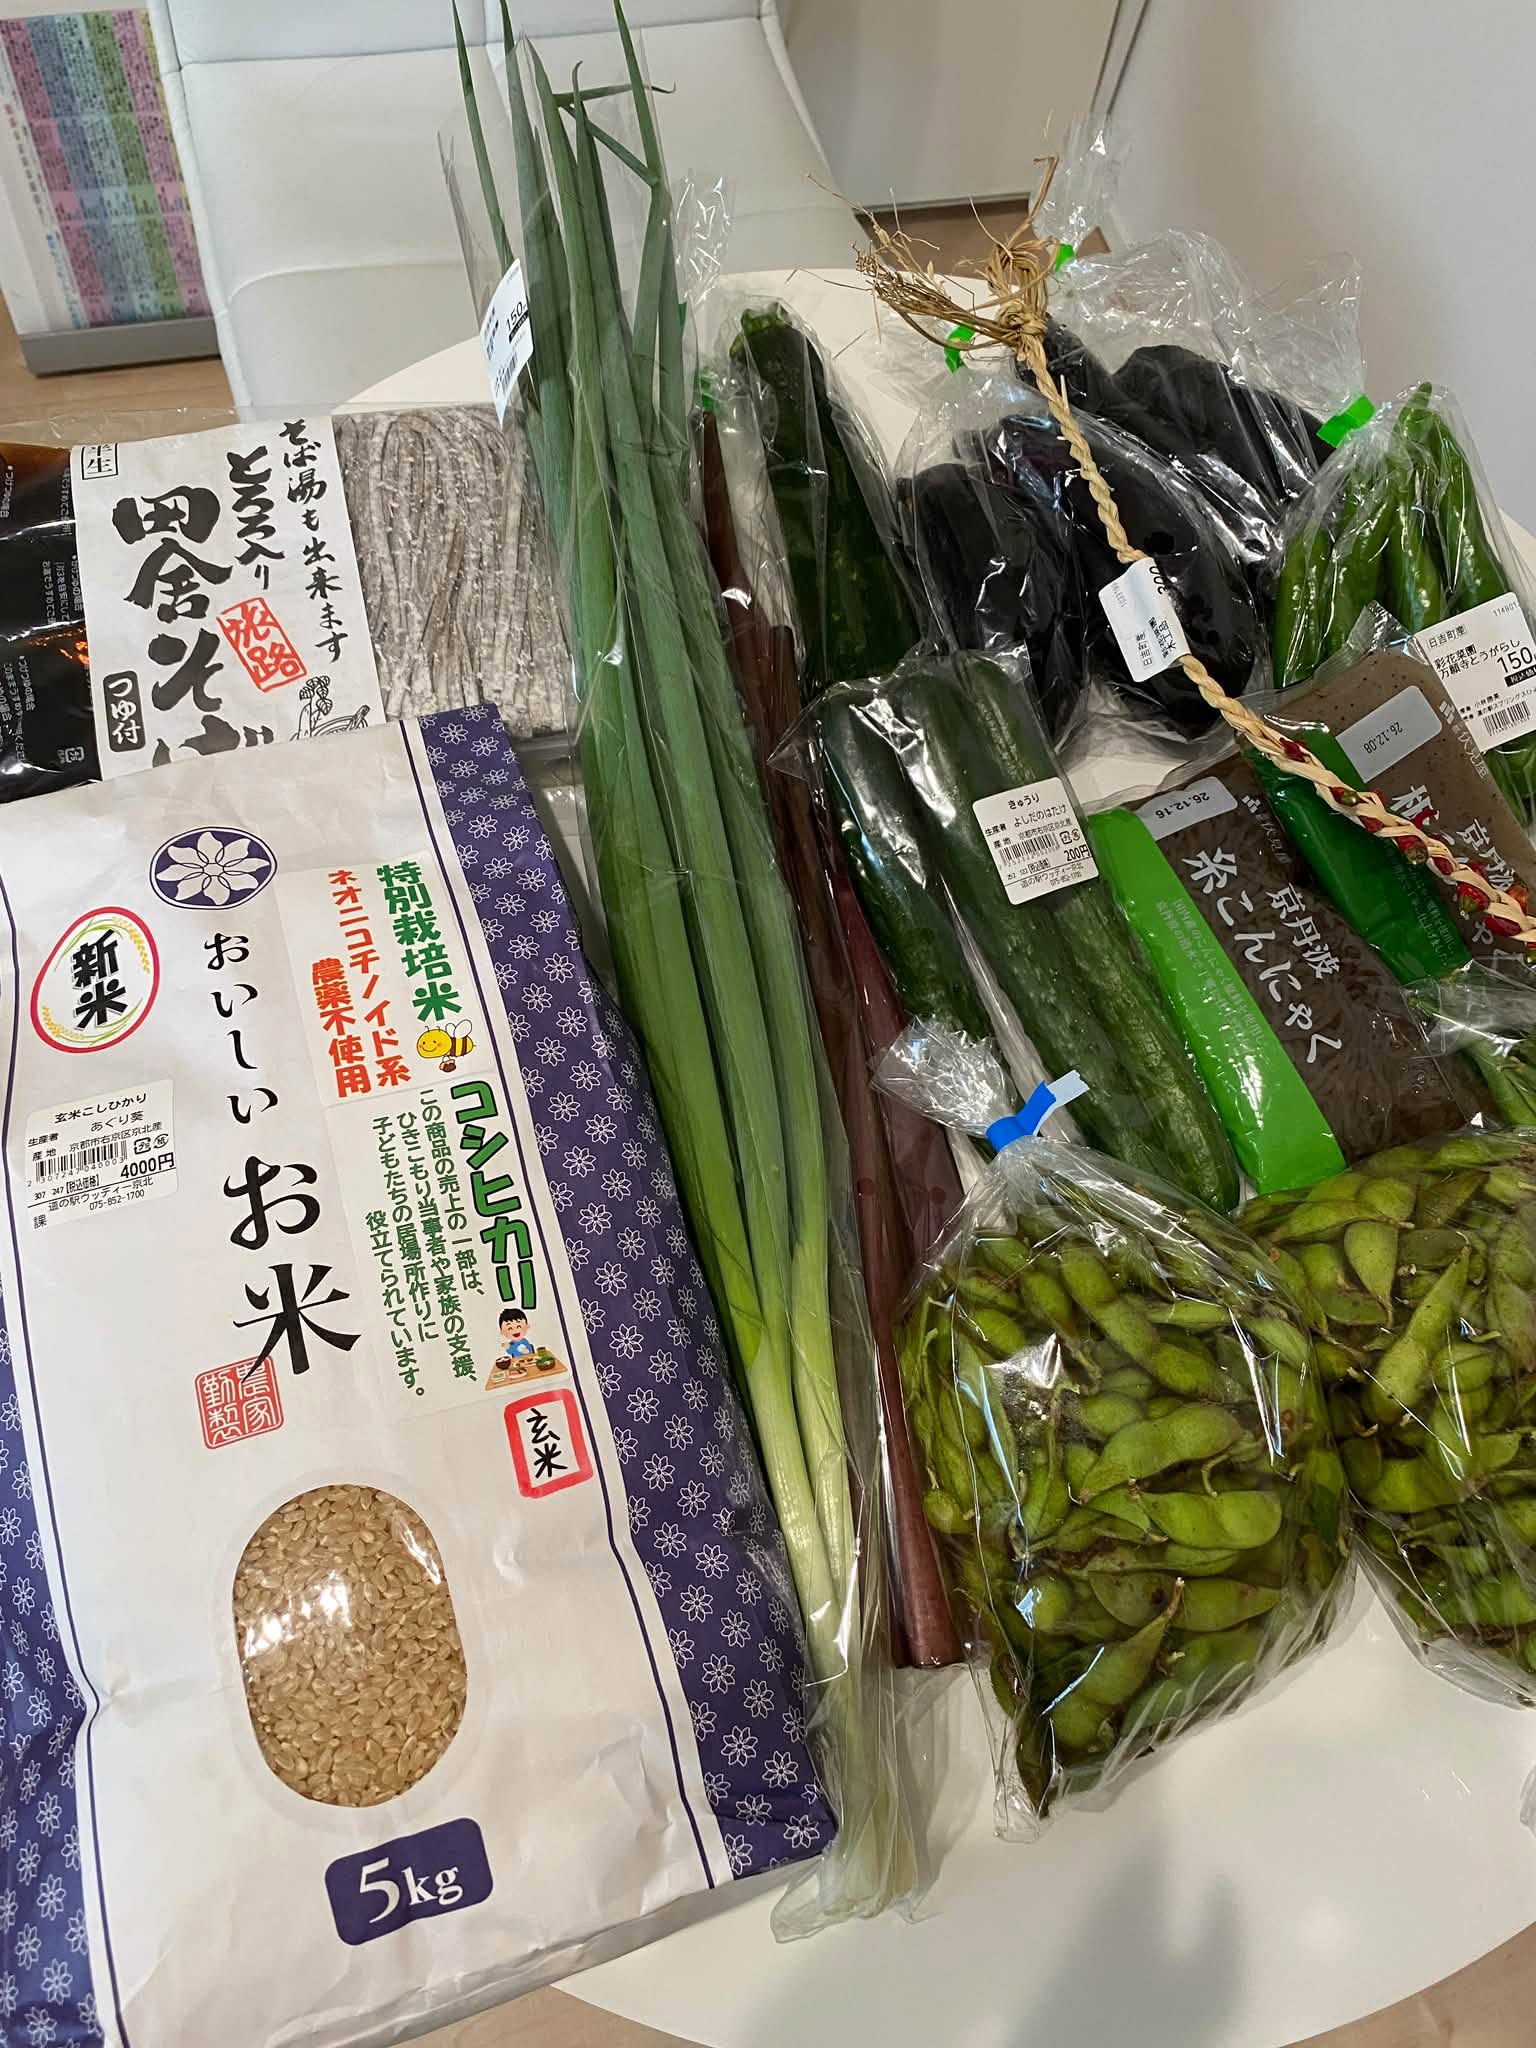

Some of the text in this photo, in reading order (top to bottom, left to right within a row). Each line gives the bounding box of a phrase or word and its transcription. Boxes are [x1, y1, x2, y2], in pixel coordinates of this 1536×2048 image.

[226, 446, 285, 590] とろろ入り
[279, 419, 348, 662] そば湯も出来ます
[1428, 624, 1467, 648] 日吉町産
[1439, 639, 1521, 680] 万願寺とうがらし
[1496, 646, 1536, 673] 150
[108, 677, 142, 746] つゆ付
[1365, 720, 1404, 755] 26.12.08
[1008, 792, 1040, 810] きゅうり
[1014, 804, 1067, 828] よしだのはたけ
[1155, 791, 1210, 820] 26.12.16
[1064, 844, 1091, 862] 200円
[376, 860, 463, 1021] 特別栽培米
[1181, 846, 1341, 1064] 糸こんにゃく
[1266, 883, 1341, 980] 京丹波
[71, 929, 128, 1030] 新米
[328, 869, 411, 1087] ネオニコチノイド系
[312, 957, 372, 1098] 農薬不使用
[27, 1110, 145, 1148] 生産者 あぐり葵
[54, 1093, 147, 1124] 玄米こしひかり
[69, 1120, 163, 1153] 京都市右京区京北産
[120, 1152, 175, 1180] 4000円
[203, 933, 362, 1384] おいしいお米
[33, 1214, 48, 1230] 課
[34, 1189, 46, 1200] 307
[51, 1186, 65, 1196] 247
[89, 1189, 146, 1211] 075-852-1700
[419, 1089, 485, 1297] この商品の売上の一部は、
[451, 1080, 537, 1310] コシヒカリ
[373, 1116, 438, 1342] 子どもたちの居場所作りに
[397, 1111, 478, 1383] ひきこもり当事者や家族の支援、
[365, 1210, 424, 1396] 役立てられています。
[526, 1408, 567, 1479] 玄米
[356, 1858, 463, 1925] 5kg
